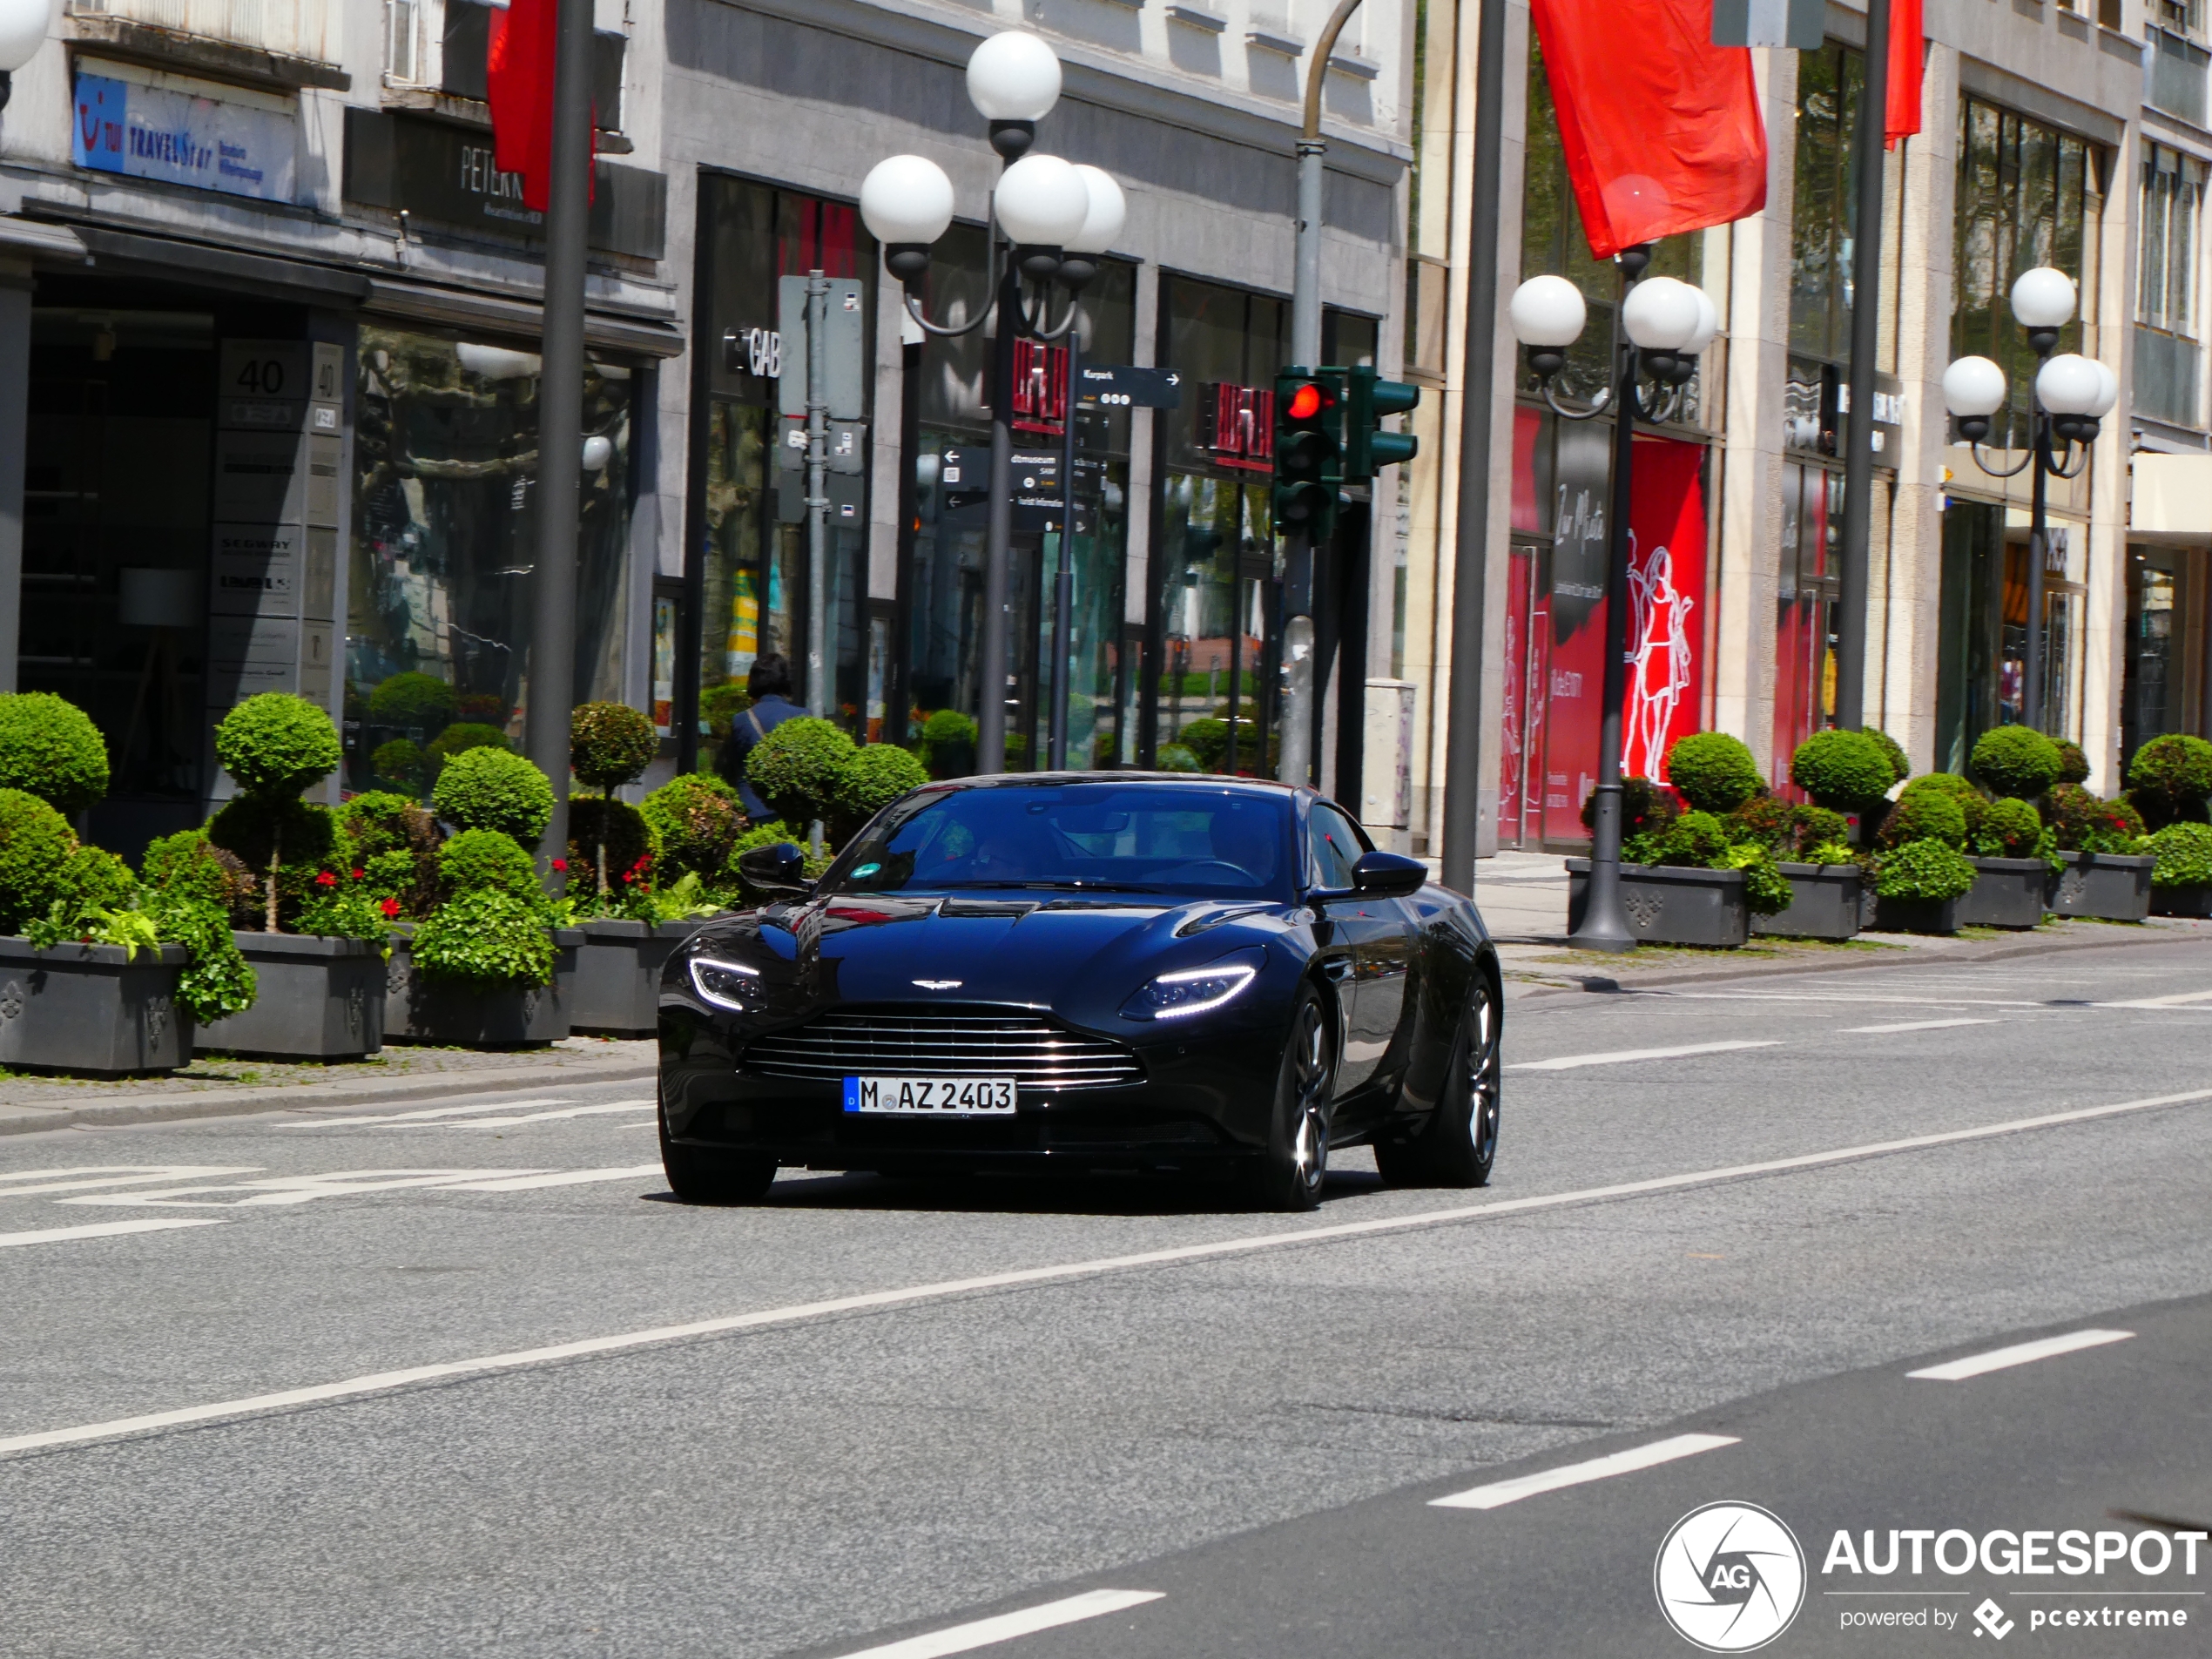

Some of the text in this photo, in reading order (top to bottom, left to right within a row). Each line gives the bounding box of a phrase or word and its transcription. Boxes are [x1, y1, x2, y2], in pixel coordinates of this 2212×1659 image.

[237, 359, 284, 395] 40
[1082, 369, 1114, 381] Kurpark
[221, 538, 291, 550] SEGWAY
[848, 1096, 855, 1105] D
[860, 1081, 1011, 1109] M AZ 2403
